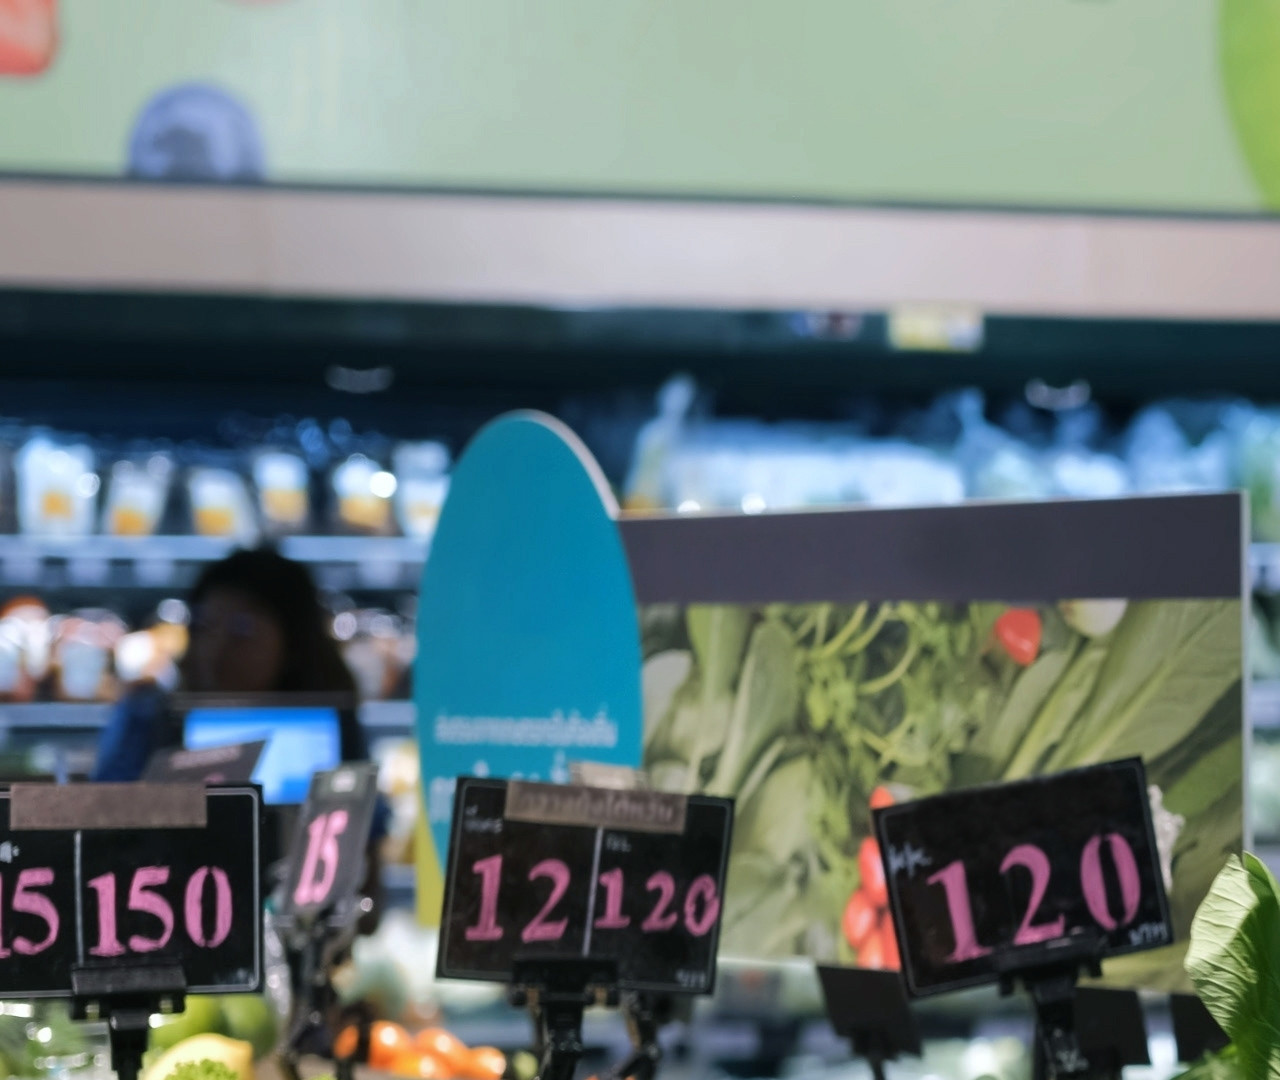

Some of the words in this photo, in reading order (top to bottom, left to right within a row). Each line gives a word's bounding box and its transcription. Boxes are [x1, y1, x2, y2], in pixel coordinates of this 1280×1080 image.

[0, 866, 60, 958] 5
[87, 865, 234, 958] 150
[464, 853, 571, 943] 12
[593, 866, 721, 937] 120
[926, 832, 1142, 963] 120
